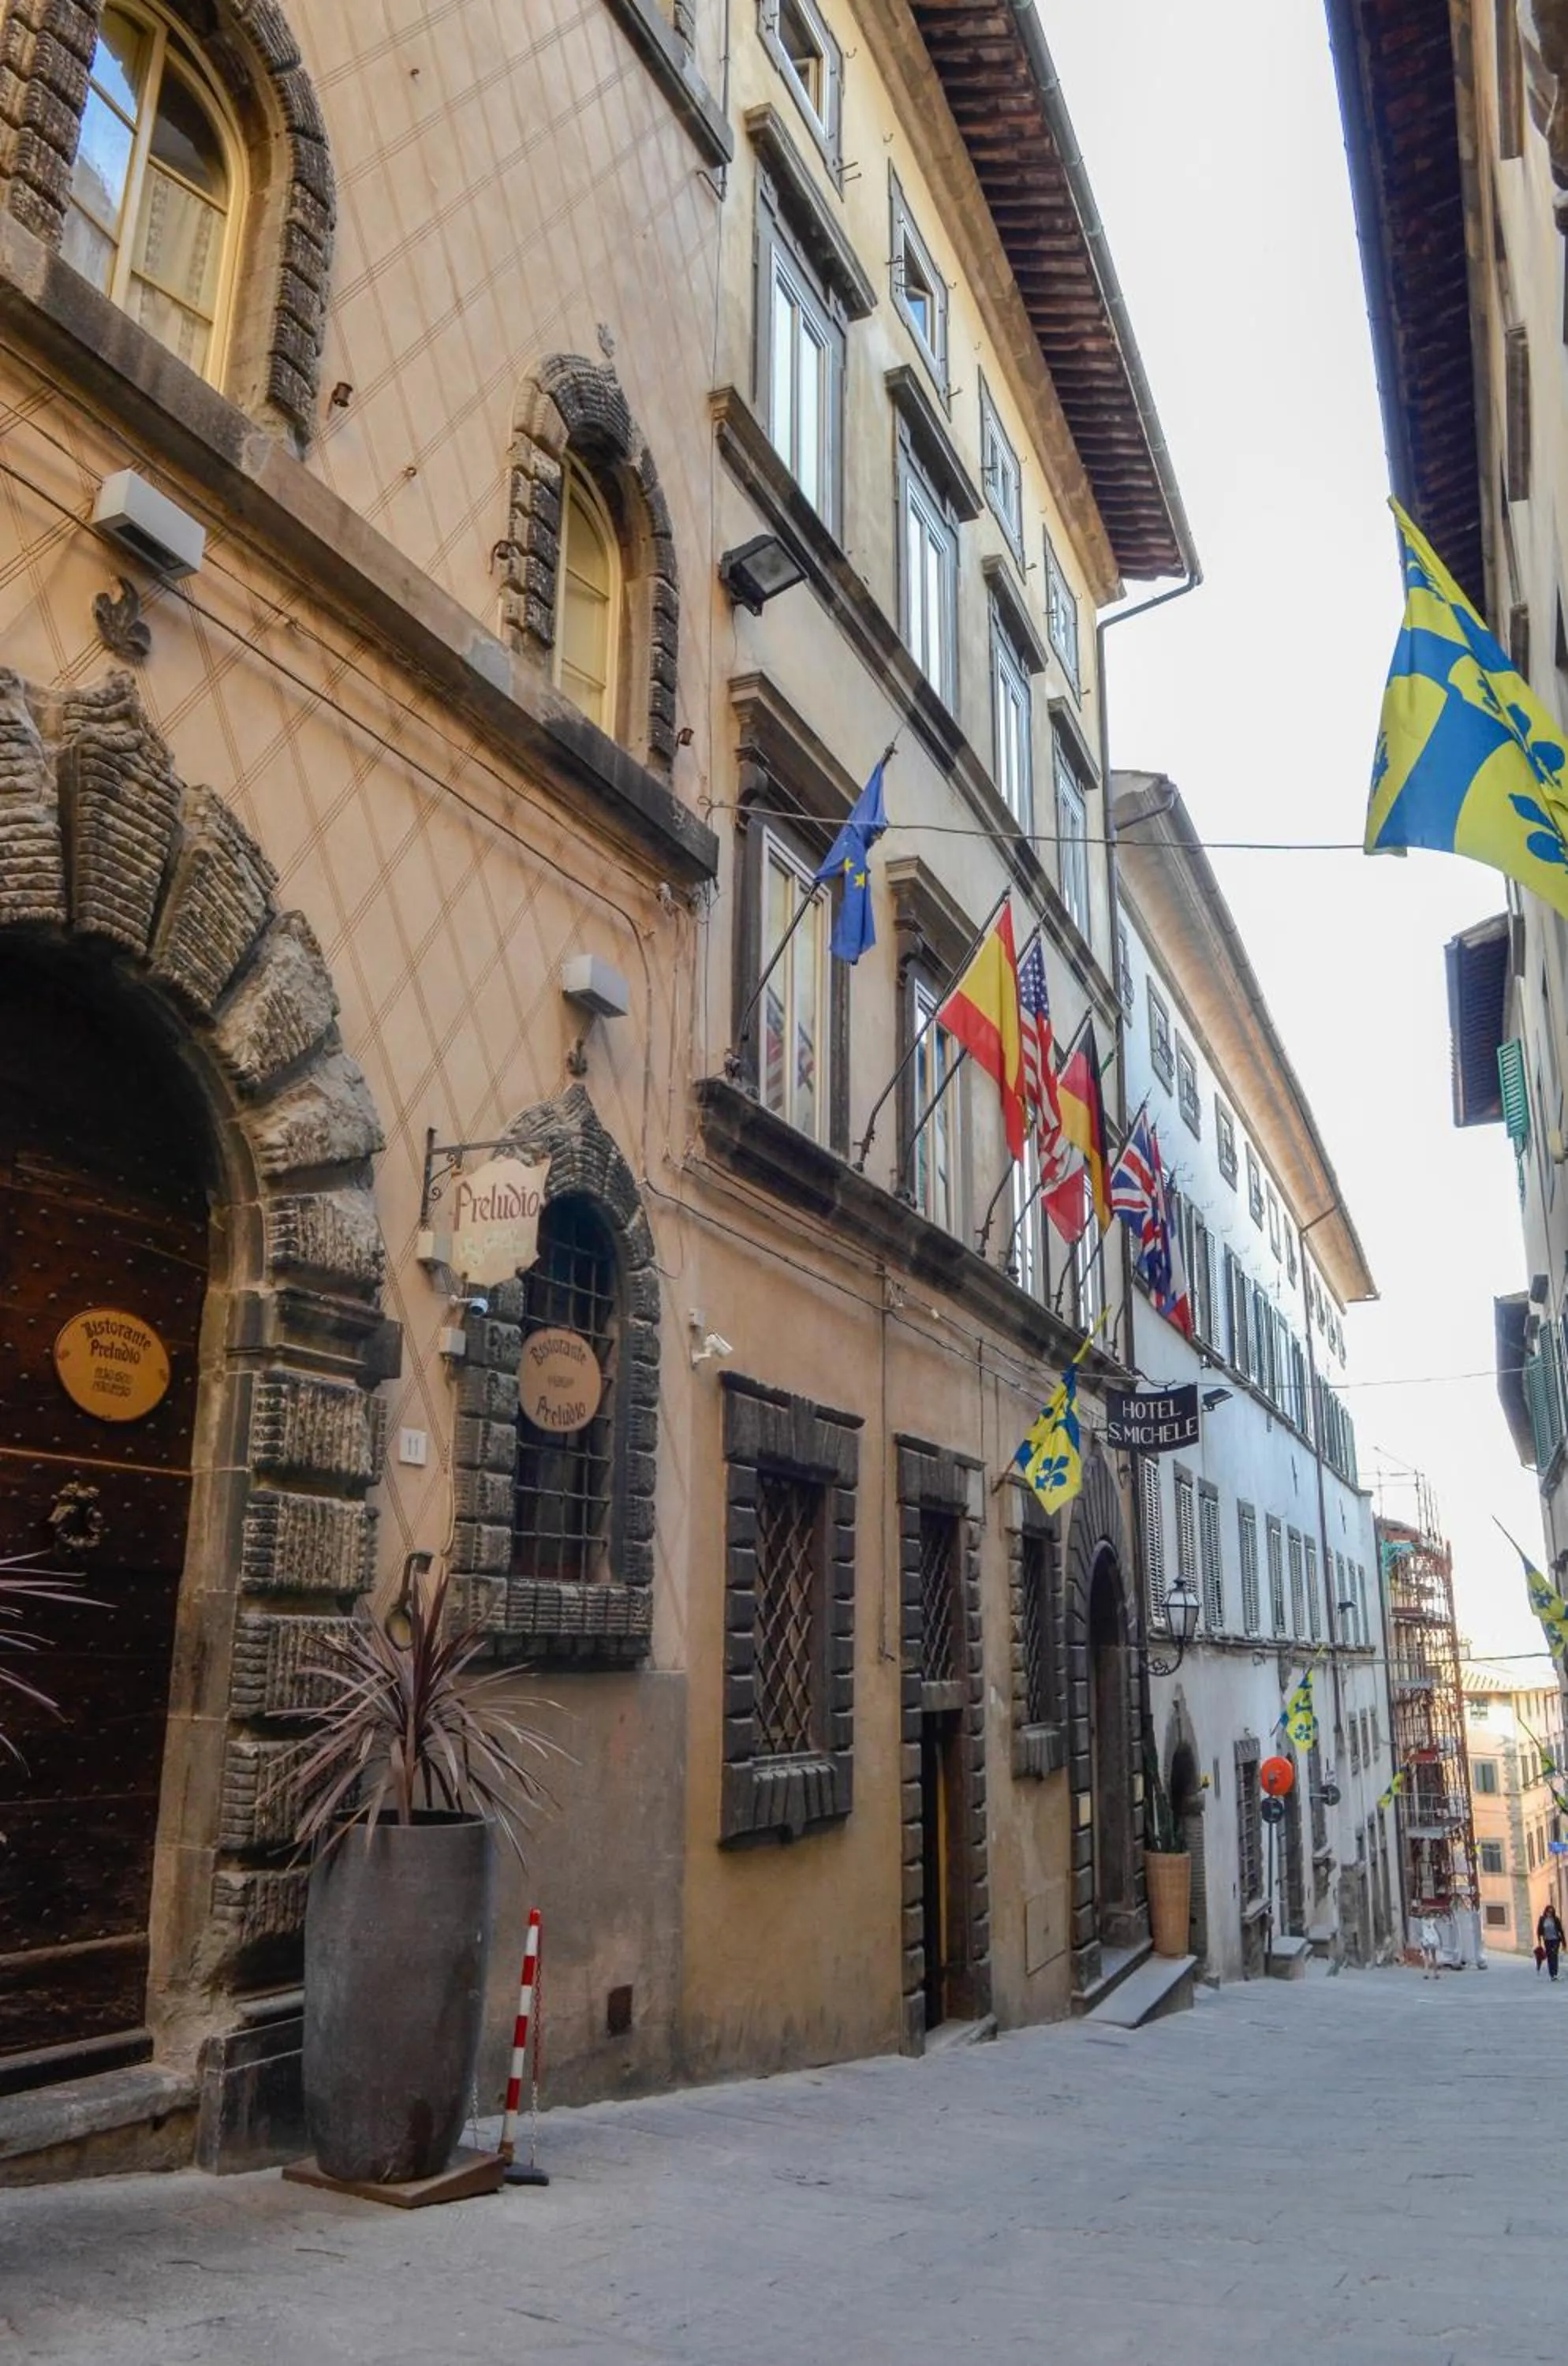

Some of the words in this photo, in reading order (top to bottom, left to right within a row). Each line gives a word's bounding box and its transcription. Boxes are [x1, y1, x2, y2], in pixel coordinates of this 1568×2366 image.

[448, 1181, 539, 1231] Preludio
[81, 1319, 151, 1351] Ristorante
[90, 1339, 140, 1364] Preludio
[530, 1339, 587, 1366] Ristorante
[536, 1395, 586, 1426] Preludio
[1122, 1399, 1182, 1419] HOTEL
